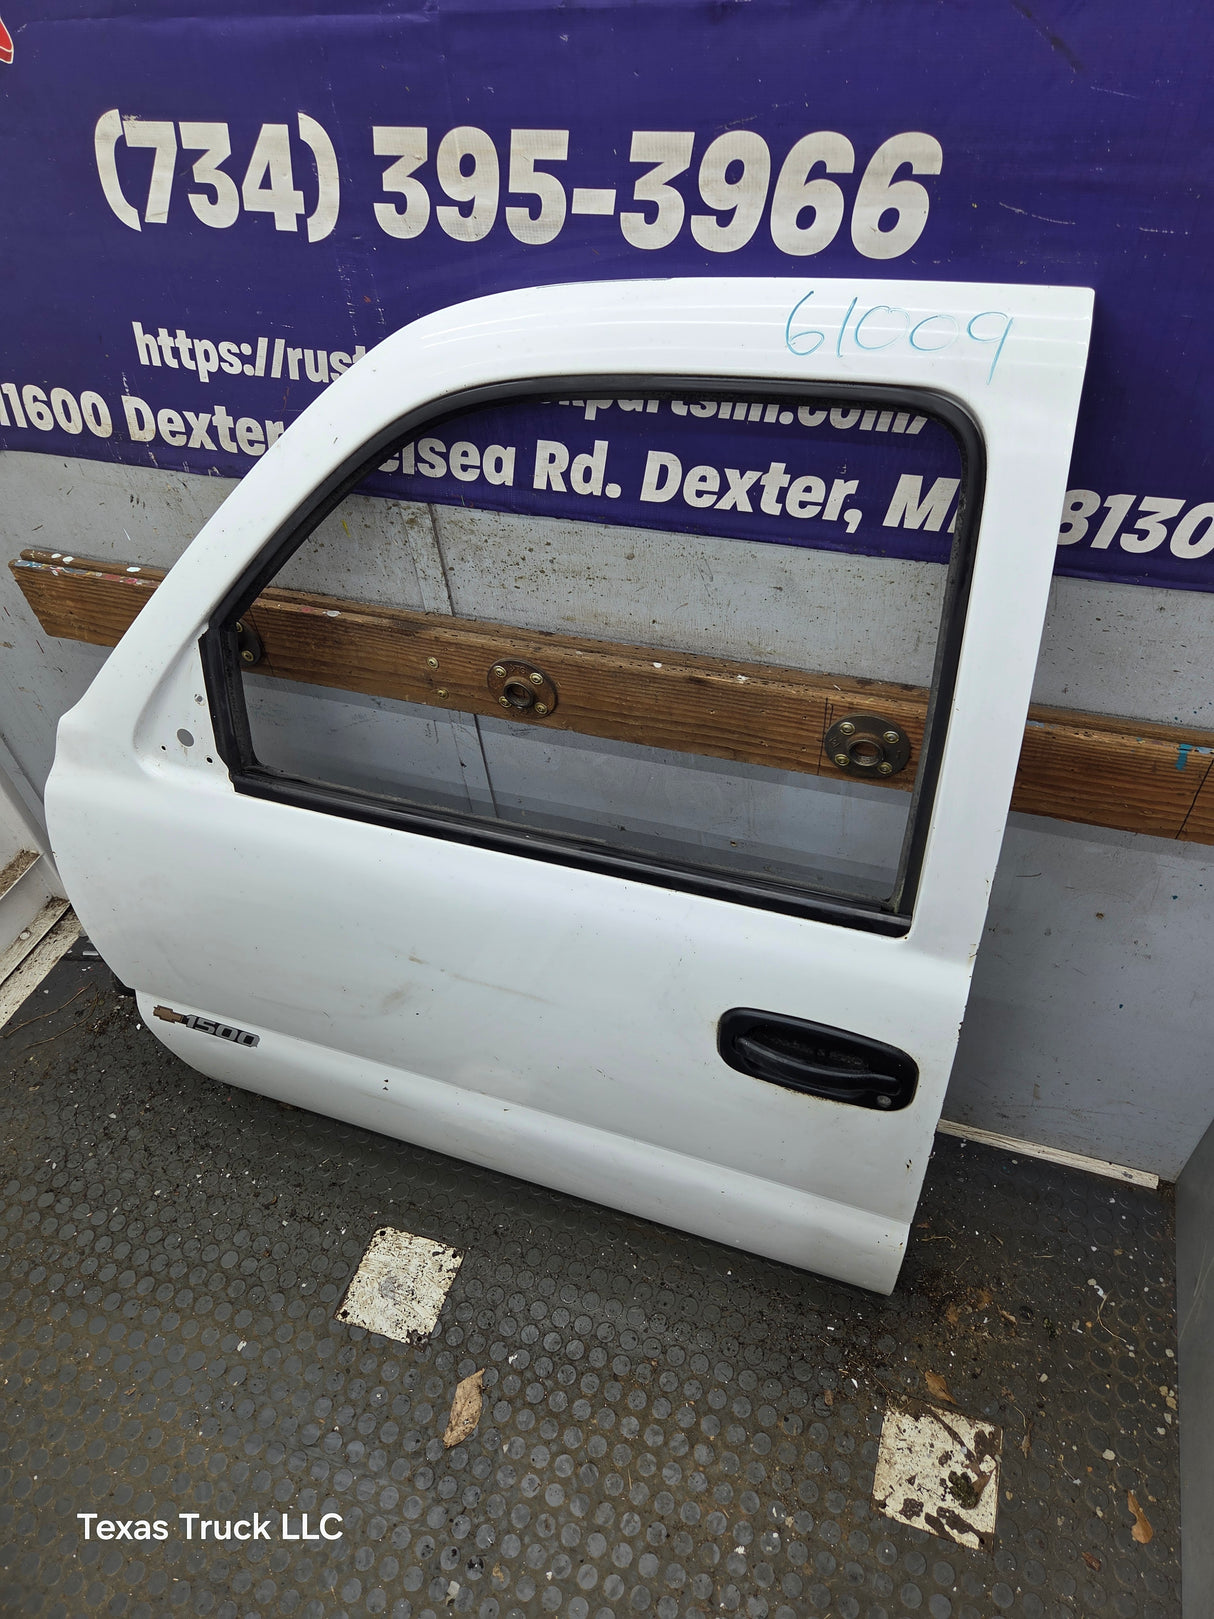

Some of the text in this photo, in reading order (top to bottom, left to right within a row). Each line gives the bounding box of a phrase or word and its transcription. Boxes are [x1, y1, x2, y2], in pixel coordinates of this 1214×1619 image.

[94, 108, 944, 260] (734) 395-3966
[785, 290, 1014, 385] 61009
[121, 394, 285, 456] Dexter
[533, 439, 622, 499] Rd.
[639, 450, 863, 534] Dexter,
[184, 1014, 260, 1048] 1500
